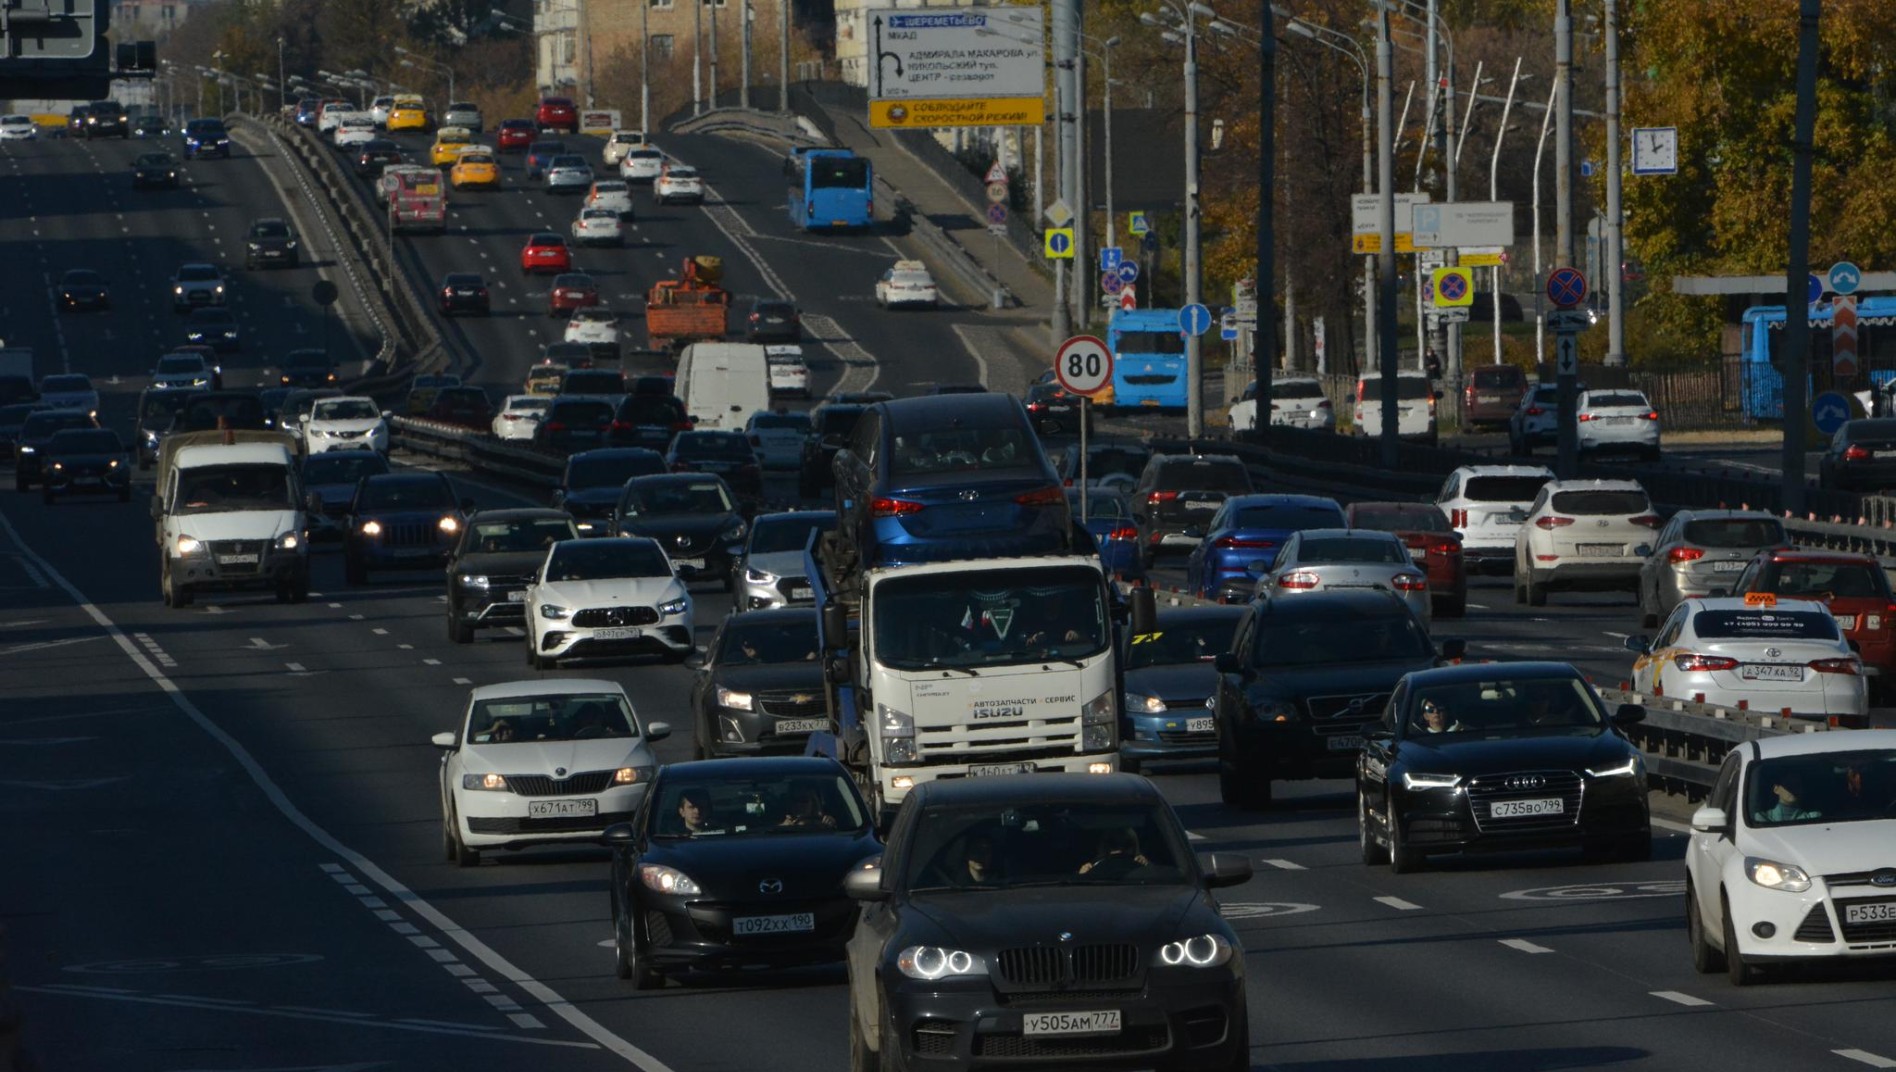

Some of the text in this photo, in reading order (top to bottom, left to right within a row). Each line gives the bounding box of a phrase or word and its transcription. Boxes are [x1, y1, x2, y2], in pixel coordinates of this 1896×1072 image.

[905, 16, 984, 27] ШЕРЕМЕТЬЕВО
[888, 31, 917, 40] МКАД
[909, 51, 965, 60] АДМИРАЛА
[968, 49, 1023, 58] МАКАРОВА
[908, 73, 941, 82] ЦЕНТР
[914, 102, 987, 112] СОБЛЮДАЙТЕ
[914, 112, 984, 123] СКОРОСТНОЙ
[1068, 353, 1101, 377] 80
[974, 694, 1076, 708] АВТОЗАПЧАСТИ СЕРВИС
[973, 706, 1023, 719] ISUZU
